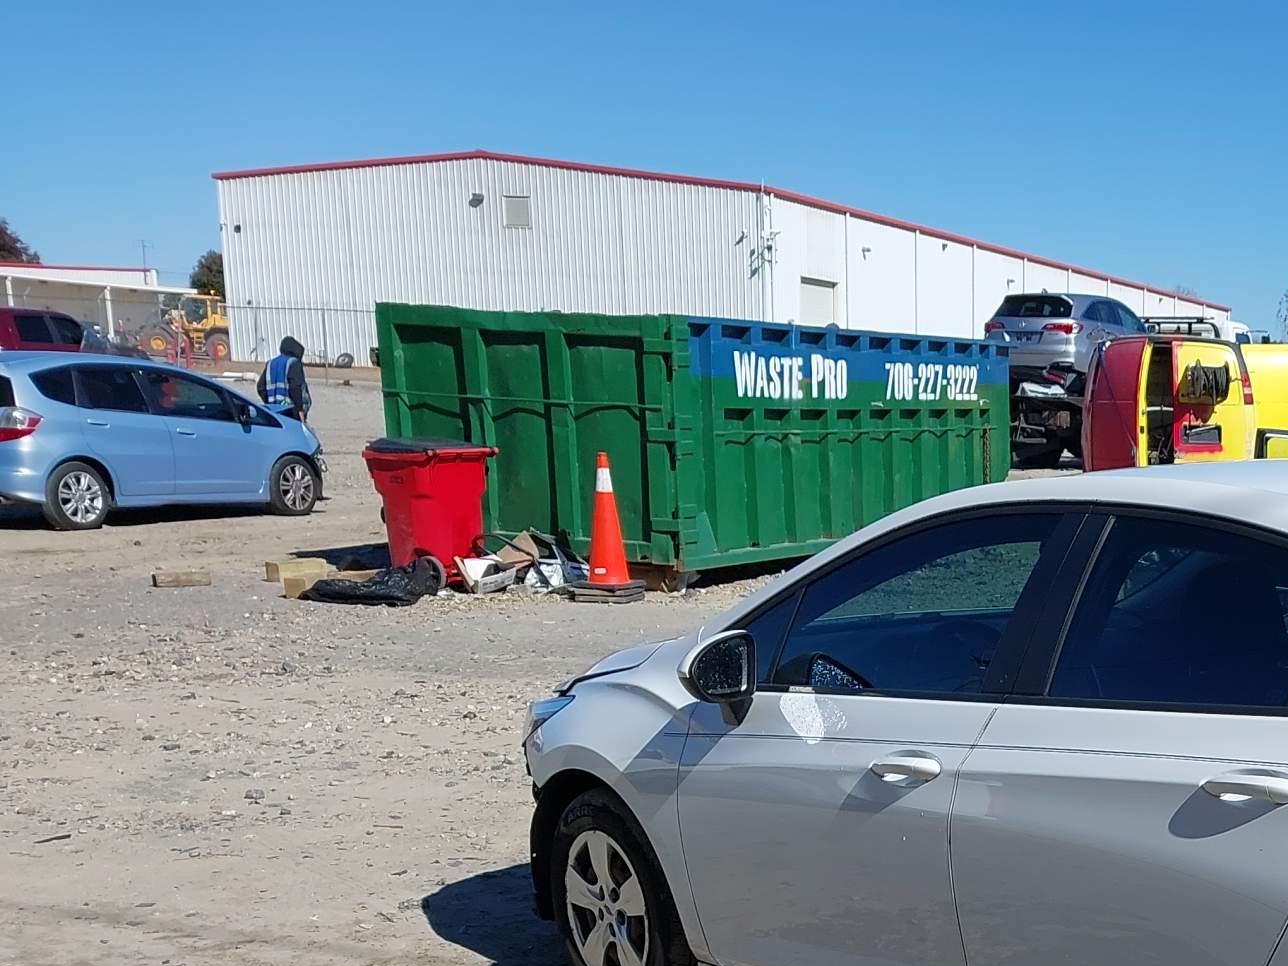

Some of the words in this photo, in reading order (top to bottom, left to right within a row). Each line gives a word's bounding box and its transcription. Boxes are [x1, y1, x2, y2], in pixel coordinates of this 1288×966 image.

[733, 350, 804, 400] WASTE
[811, 353, 848, 400] PRO
[884, 362, 978, 401] 706-227-3222
